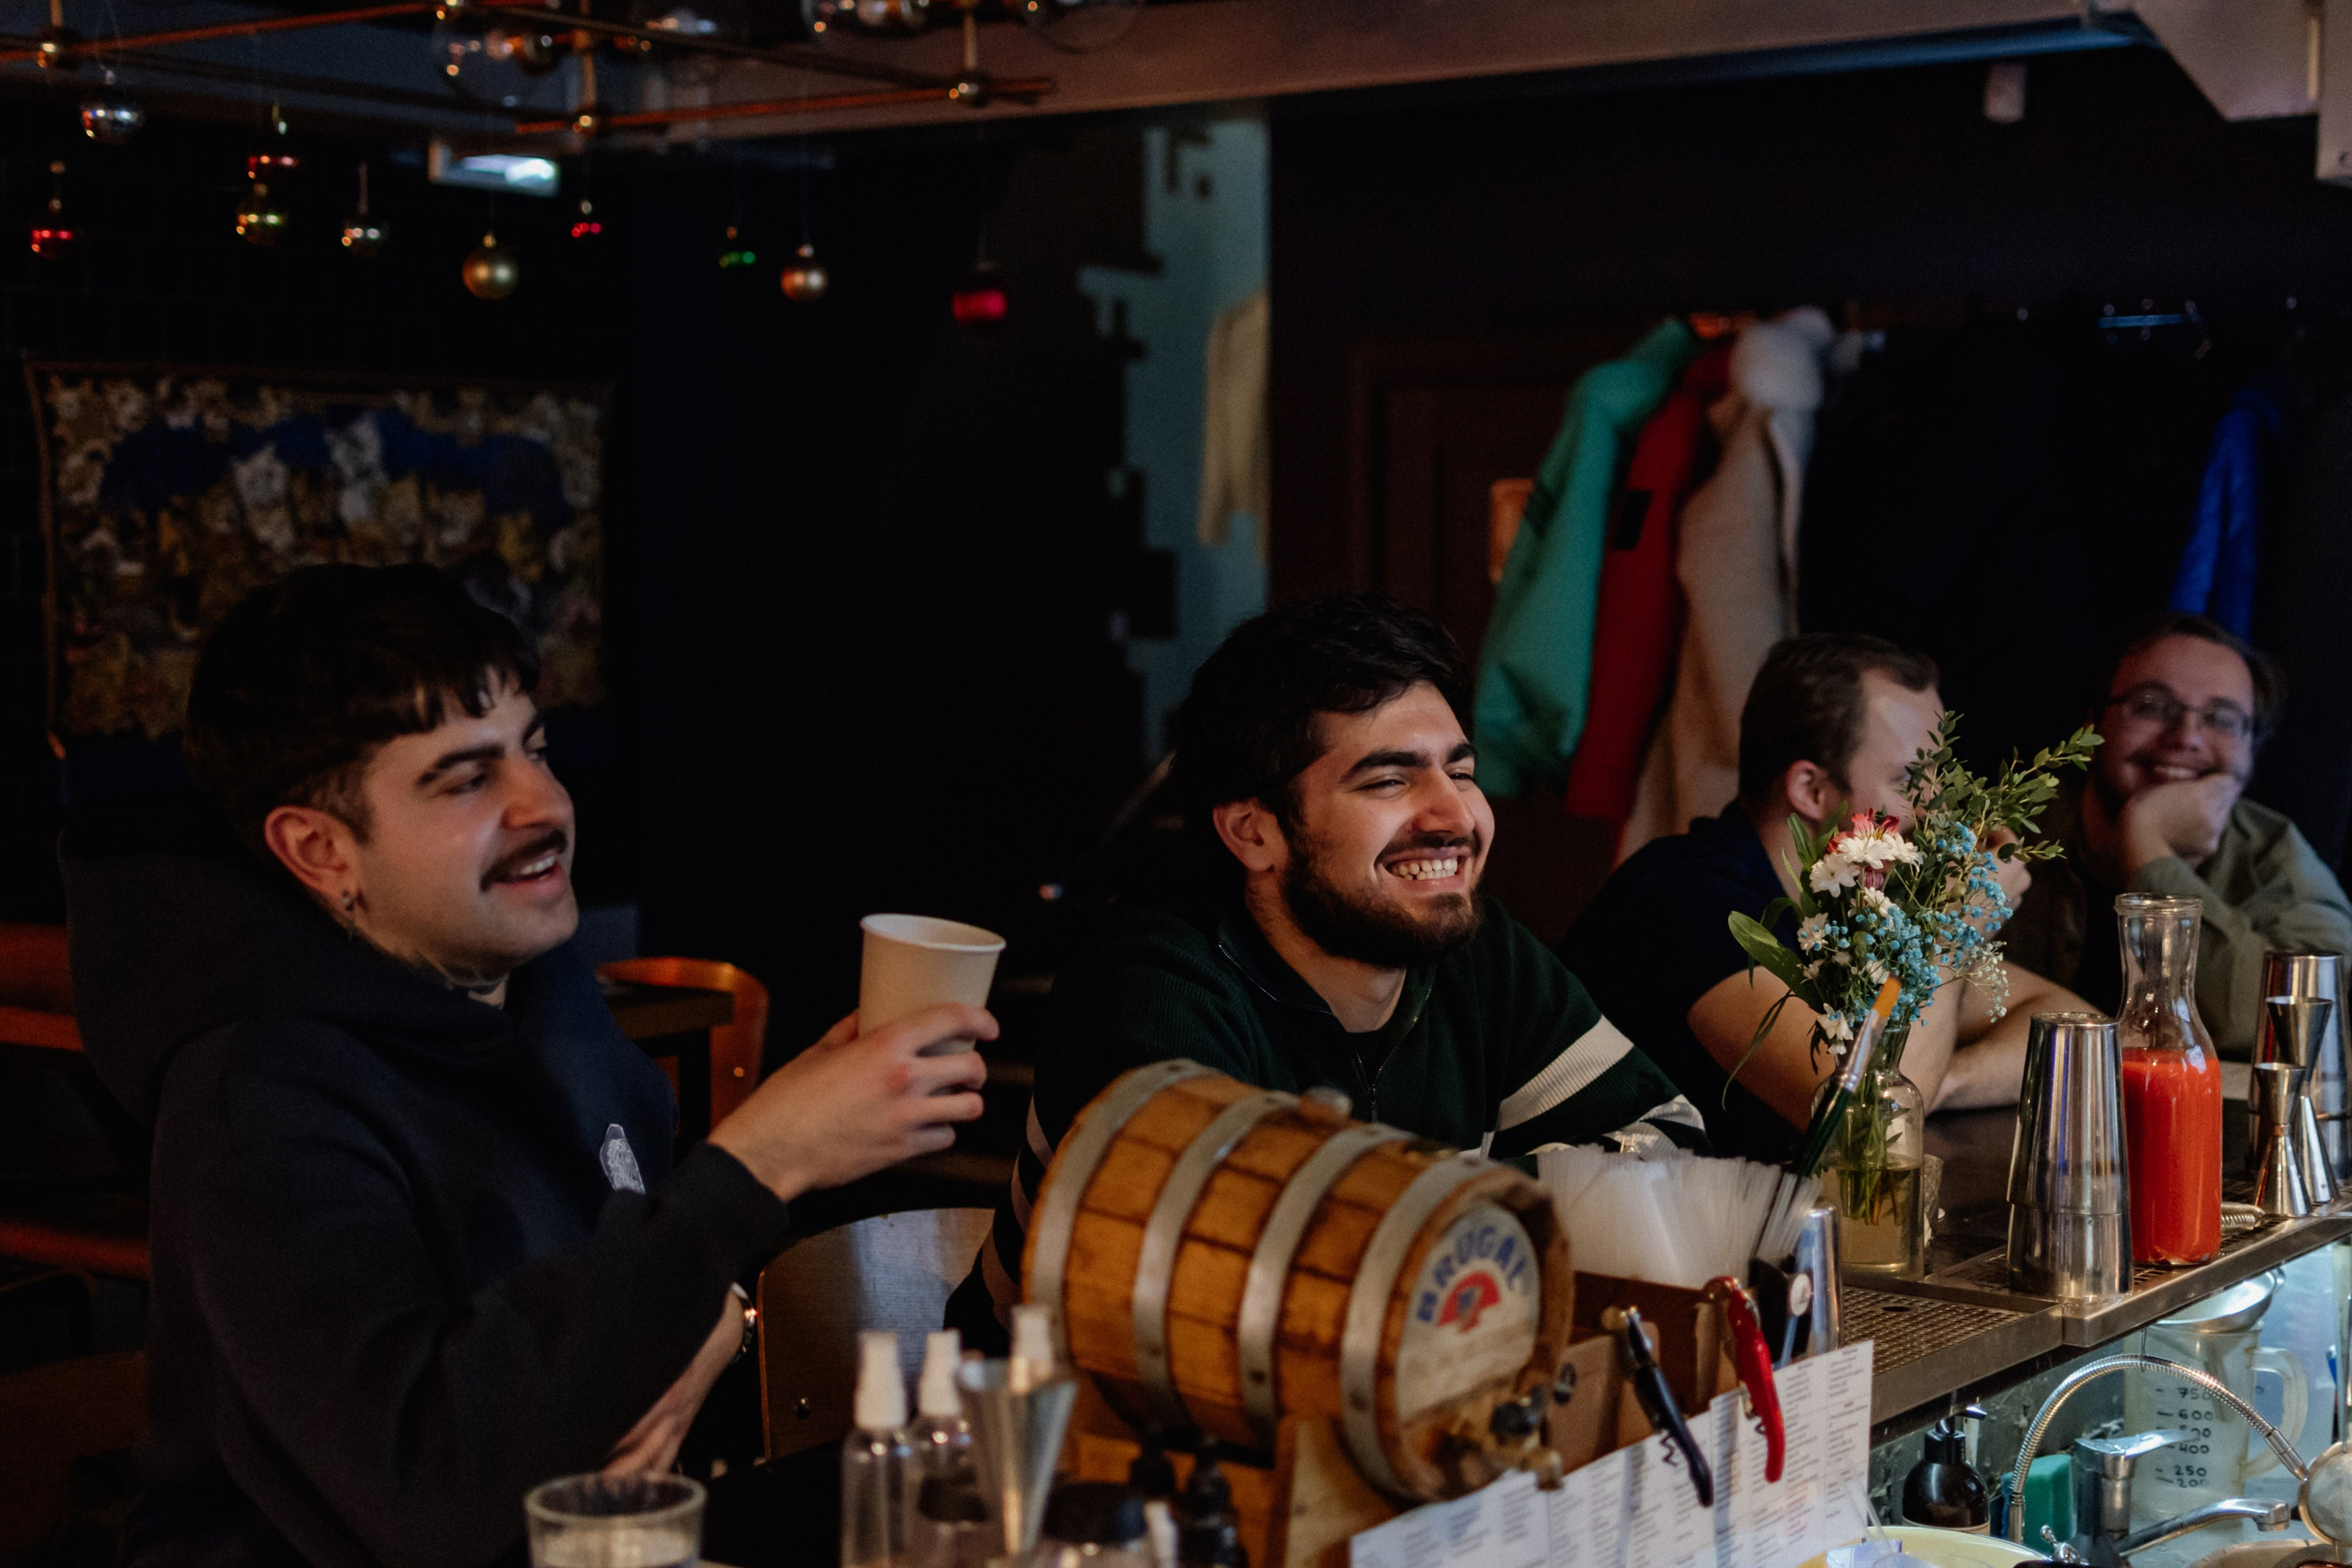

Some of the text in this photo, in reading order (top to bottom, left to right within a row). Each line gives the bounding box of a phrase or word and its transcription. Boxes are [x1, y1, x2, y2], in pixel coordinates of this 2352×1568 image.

[1417, 1225, 1526, 1323] BRUGAL
[2177, 1387, 2212, 1401] 750
[2178, 1408, 2213, 1421] 600
[2178, 1443, 2211, 1454] 400
[2174, 1464, 2207, 1477] 250
